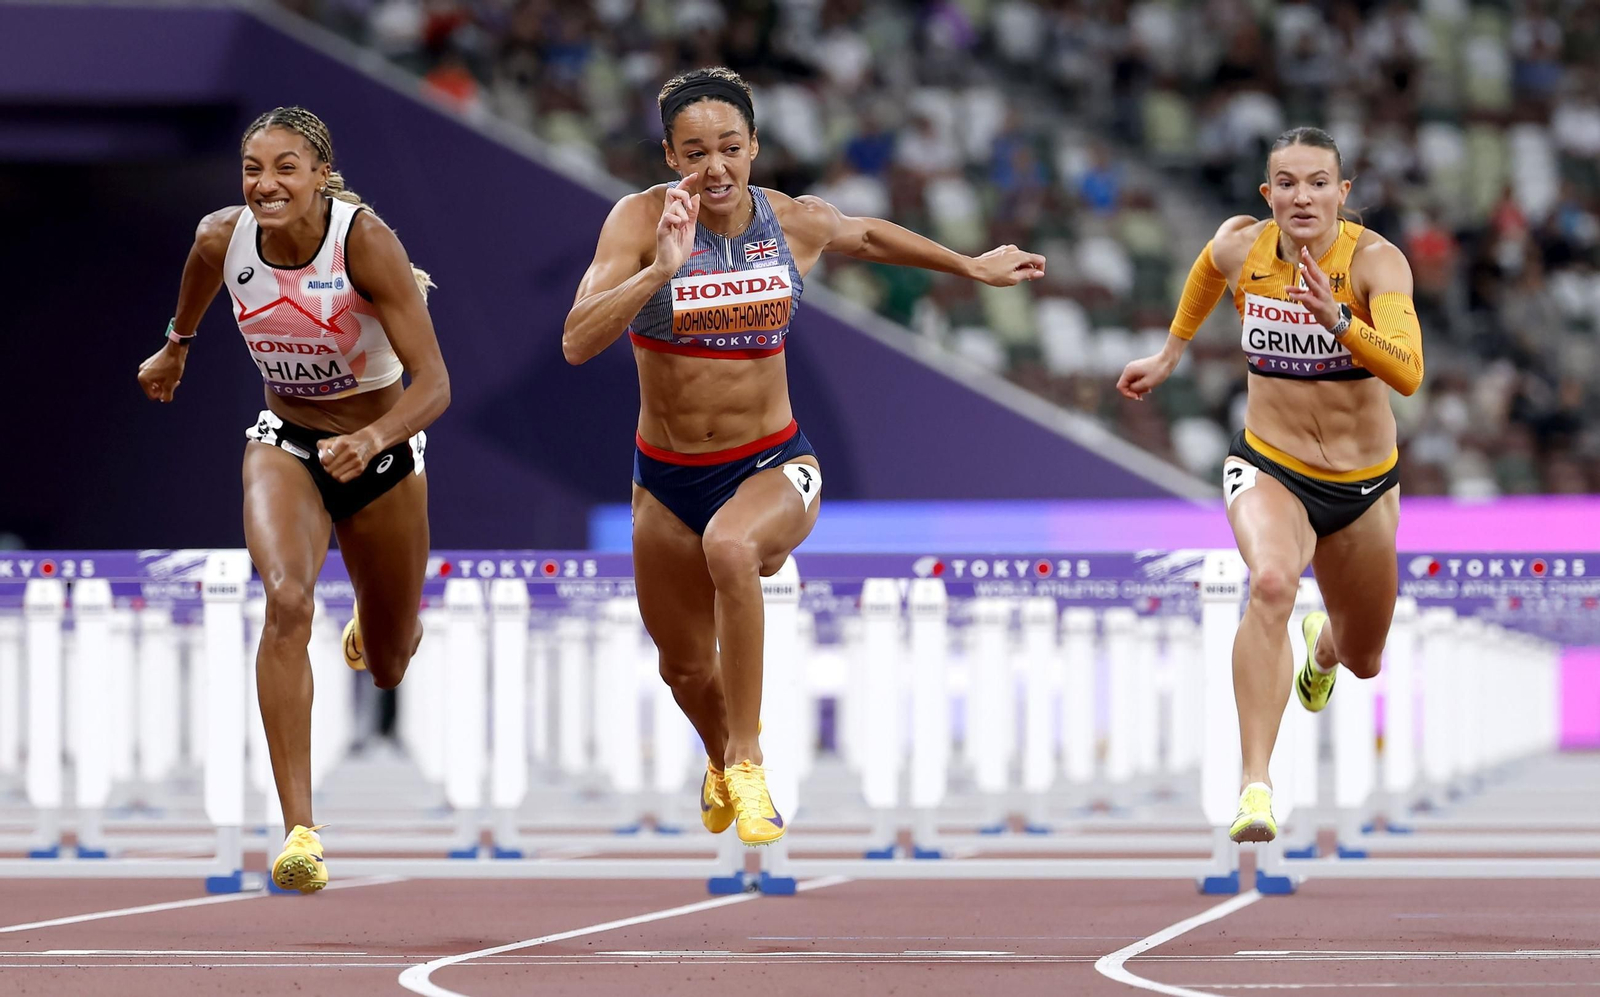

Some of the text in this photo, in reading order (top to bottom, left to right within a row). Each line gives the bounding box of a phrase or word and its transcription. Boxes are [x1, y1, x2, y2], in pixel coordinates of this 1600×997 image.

[307, 280, 333, 290] Allianz
[675, 275, 790, 302] HONDA
[676, 299, 790, 332] JOHNSON-THOMPSON
[1247, 302, 1319, 325] HOND
[1248, 328, 1343, 355] GRIMM
[1359, 326, 1412, 366] GERMANY
